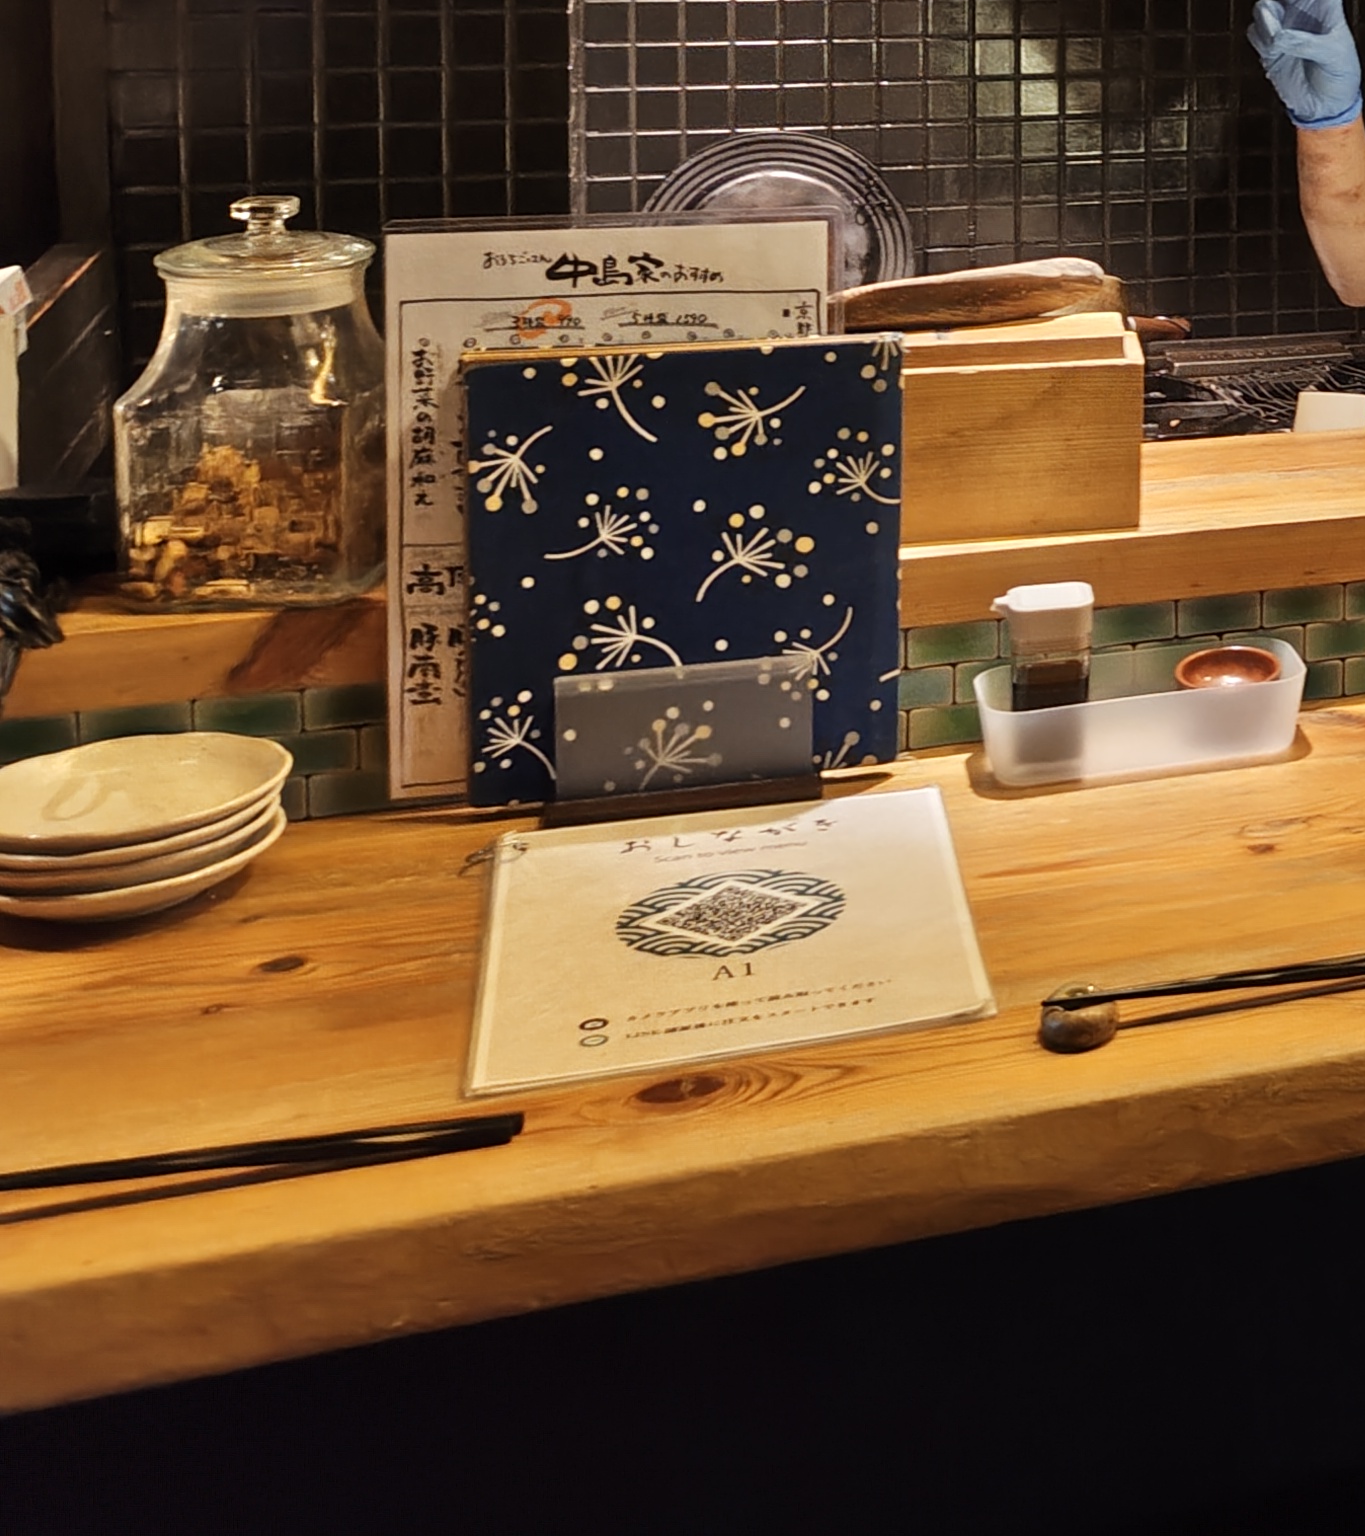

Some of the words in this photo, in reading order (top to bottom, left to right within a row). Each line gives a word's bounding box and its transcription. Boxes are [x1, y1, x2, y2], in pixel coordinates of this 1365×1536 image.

[620, 818, 839, 854] おしながき
[653, 853, 693, 864] Scan
[697, 850, 715, 860] to
[716, 846, 756, 857] view
